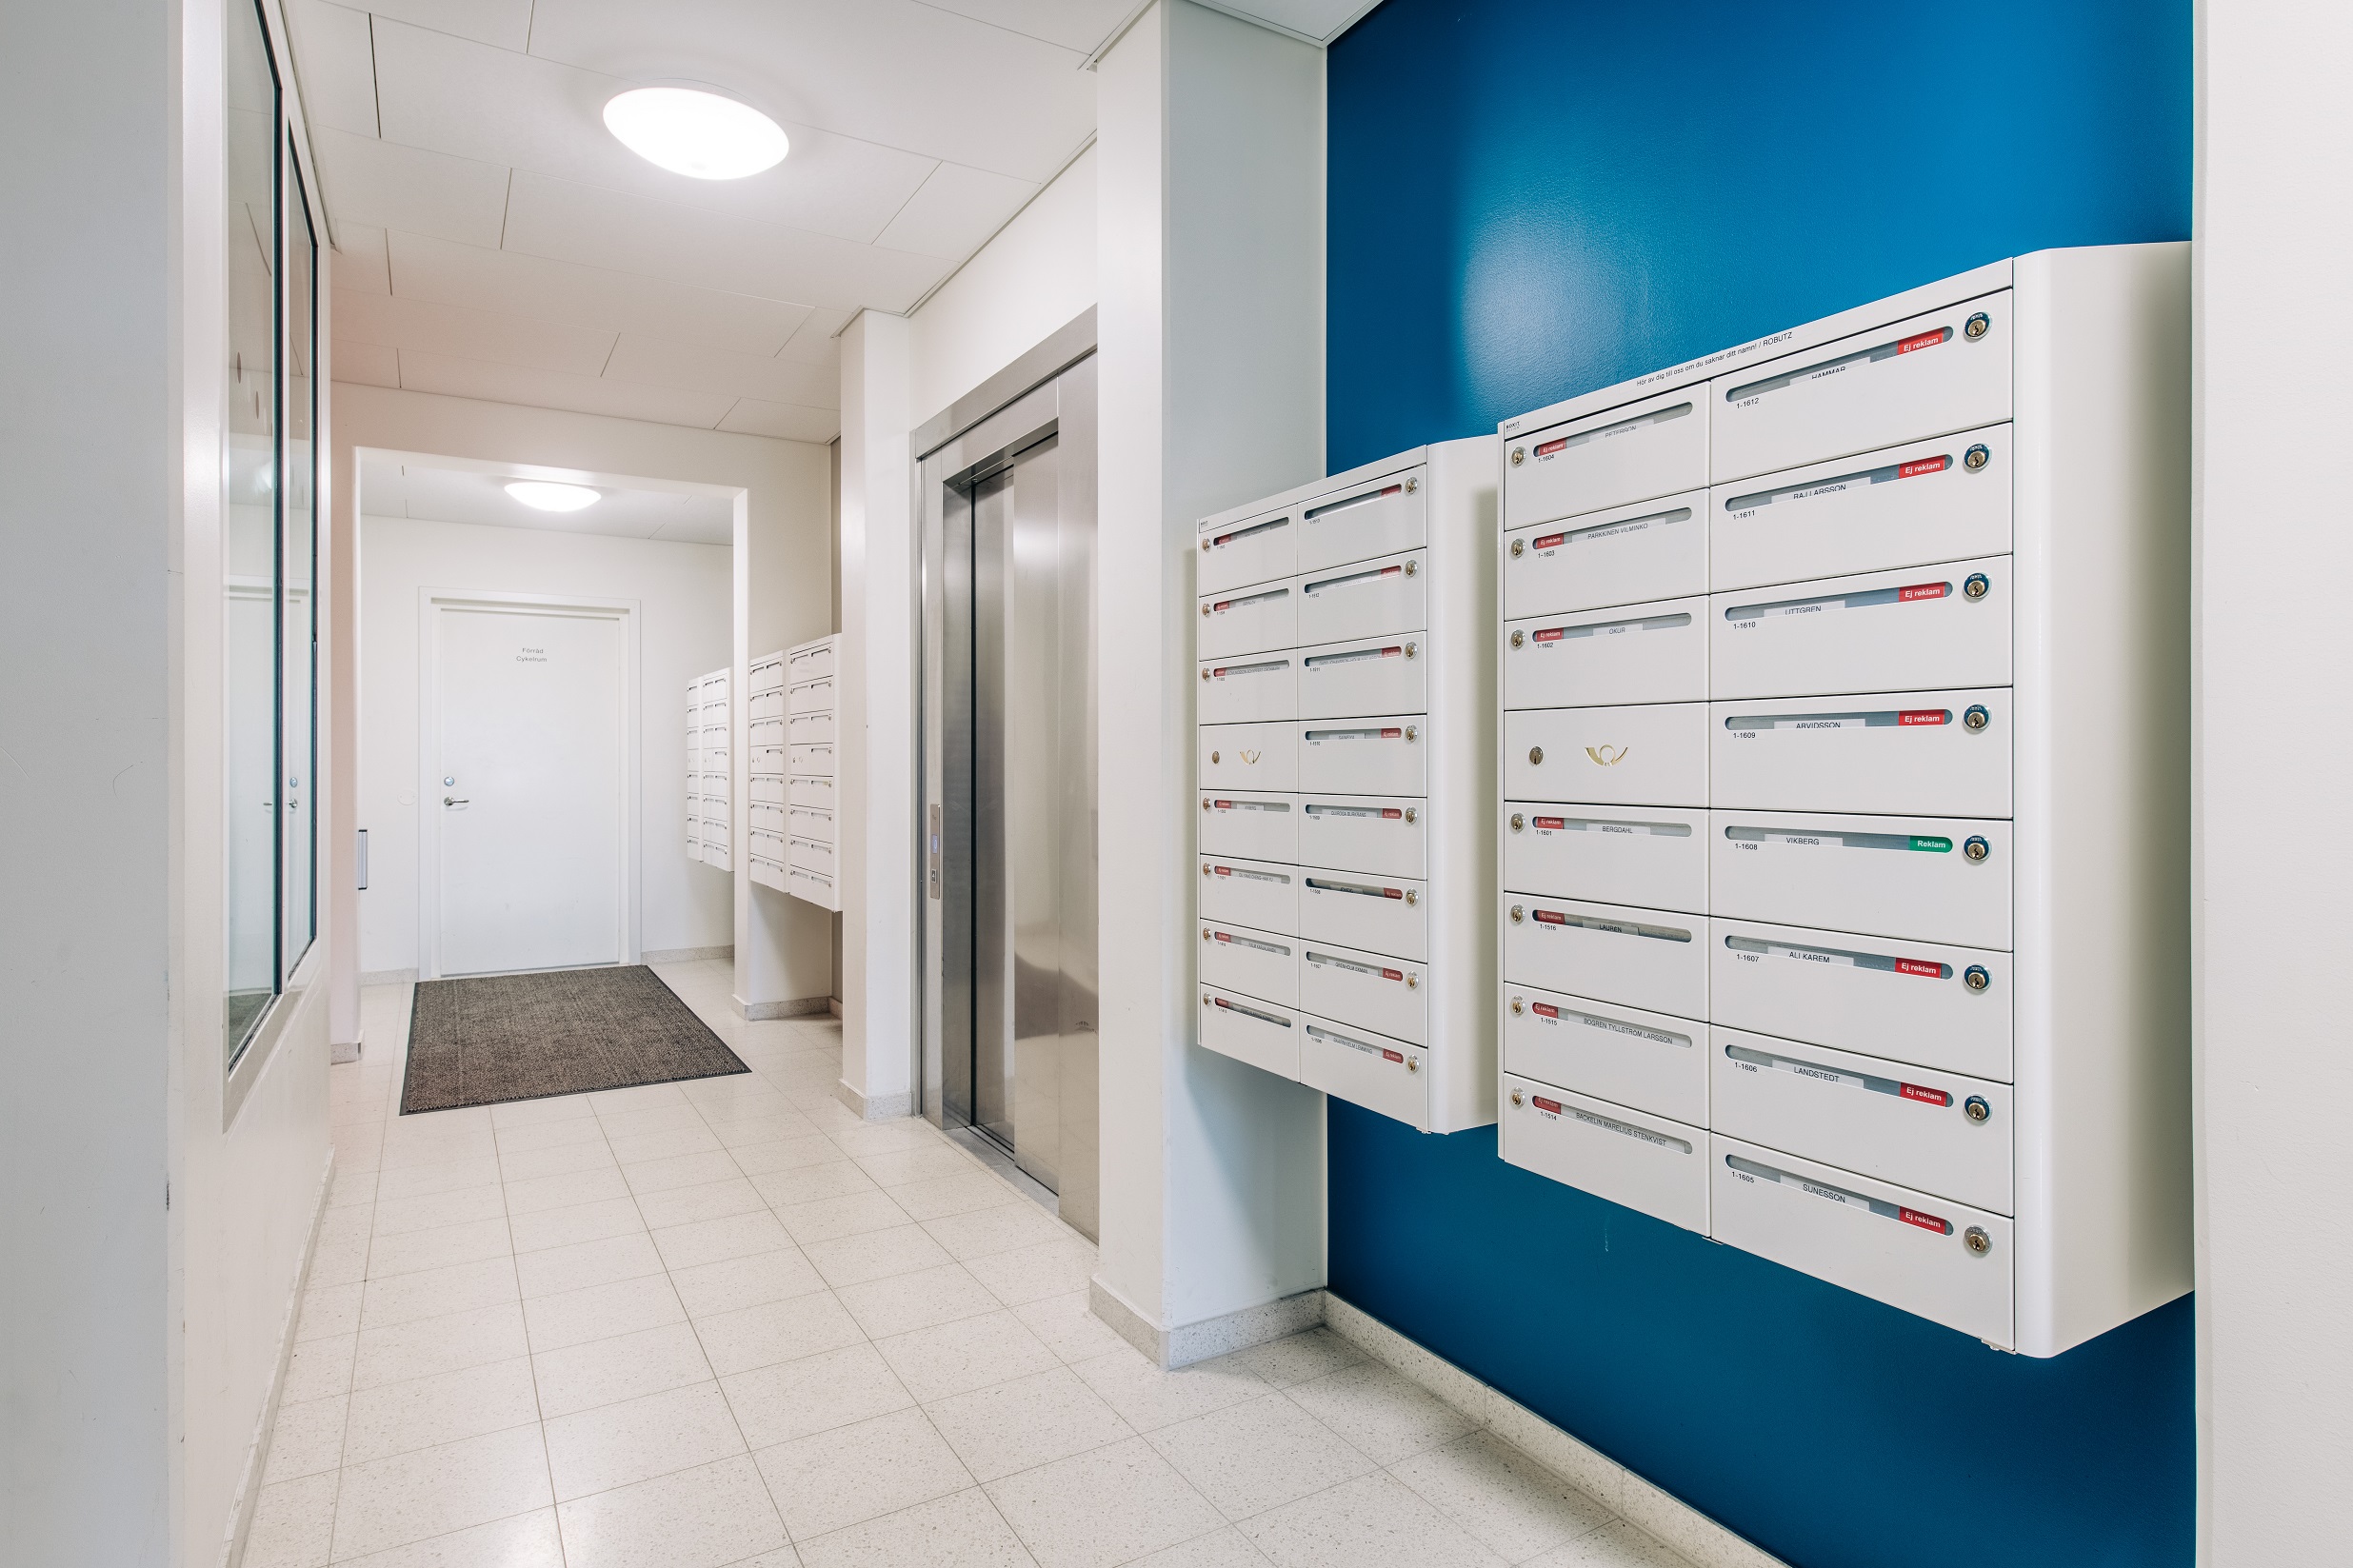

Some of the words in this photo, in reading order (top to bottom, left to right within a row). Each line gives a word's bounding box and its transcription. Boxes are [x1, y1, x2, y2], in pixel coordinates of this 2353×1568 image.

[1705, 353, 1725, 366] saknar
[1725, 349, 1737, 358] ditt
[1737, 343, 1757, 354] namn!
[1763, 331, 1793, 347] ROBUTZ
[1904, 343, 1912, 352] Ej
[1912, 337, 1939, 350] reklam
[1737, 398, 1760, 409] 1-1612
[1538, 454, 1554, 464] 1-1604
[1904, 466, 1913, 475] Ej
[1914, 462, 1941, 472] reklam
[1733, 510, 1756, 521] 1-1611
[1587, 527, 1619, 540] PARKKINEN
[1620, 523, 1648, 533] VILMINKO
[1546, 536, 1562, 545] reklam
[1904, 589, 1913, 599] Ej
[1914, 588, 1941, 597] reklam
[1733, 622, 1756, 630] 1-1610
[1917, 840, 1946, 848] Reklam
[1600, 923, 1623, 933] LAUREN
[1736, 954, 1760, 963] 1-1607
[1788, 951, 1802, 960] ALI
[1803, 953, 1830, 963] KAREM
[1901, 963, 1910, 972] Ej
[1910, 963, 1937, 975] reklam
[1541, 1017, 1558, 1026] 1-1515
[1644, 1033, 1673, 1044] LARSSON
[1734, 1062, 1758, 1072] 1-1606
[1794, 1066, 1840, 1083] LANDSTEDT
[1906, 1086, 1914, 1097] Ej
[1916, 1088, 1943, 1102] reklam
[1541, 1111, 1557, 1121] 1-1514
[1604, 1121, 1632, 1136] MARELIUS
[1633, 1131, 1666, 1146] STENKVIST
[1731, 1171, 1755, 1183] 1-1605
[1802, 1183, 1845, 1203] SUNESSON
[1905, 1211, 1913, 1221] Ej
[1914, 1214, 1941, 1228] reklam
